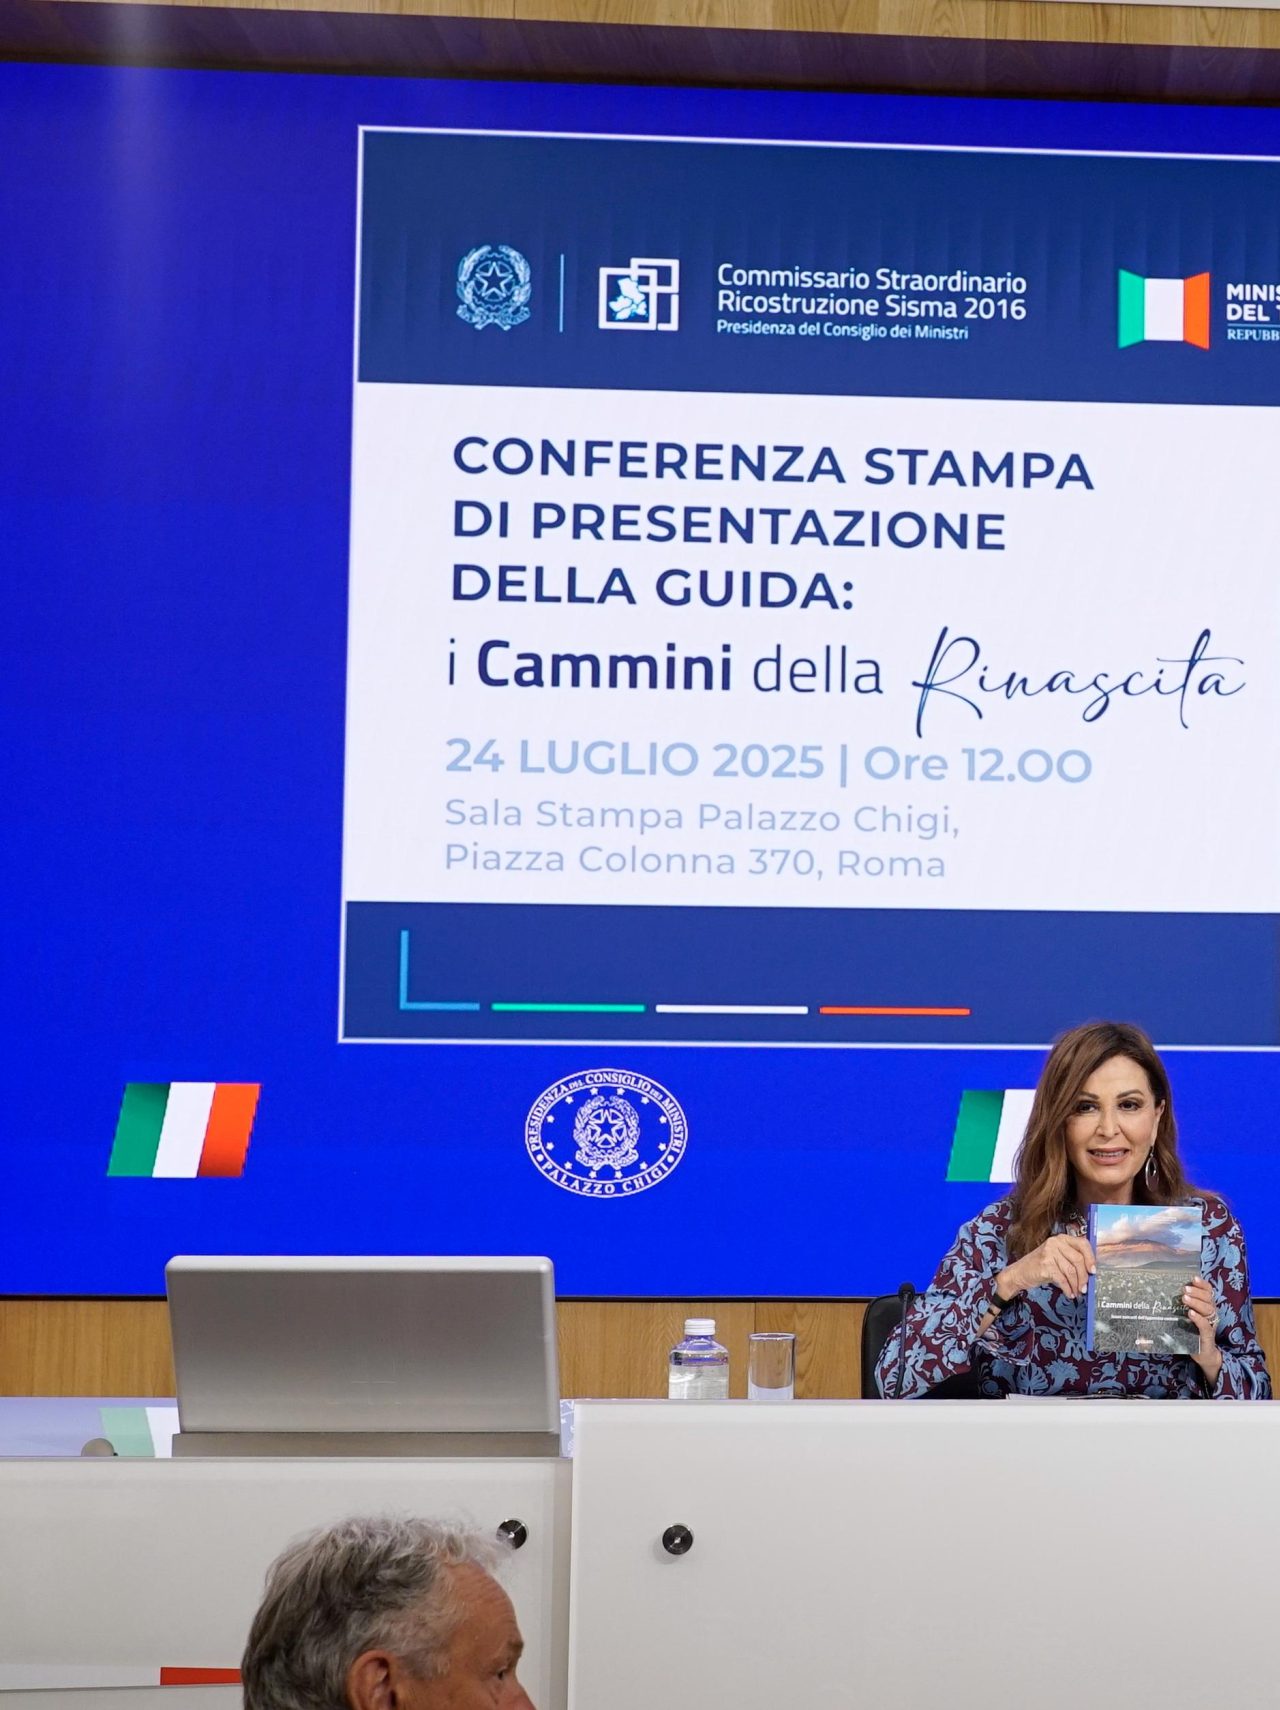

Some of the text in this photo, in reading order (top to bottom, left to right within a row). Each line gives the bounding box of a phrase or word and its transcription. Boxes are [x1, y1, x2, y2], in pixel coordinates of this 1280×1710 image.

[717, 263, 1027, 294] Commissario Straordinario
[717, 289, 1027, 321] Ricostruzione Sisma 2016
[1226, 303, 1271, 322] DEL
[716, 319, 969, 342] Presidenza del Consiglio dei Ministri
[453, 436, 1095, 491] CONFERENZA STAMPA
[453, 499, 1006, 551] DI PRESENTAZIONE
[452, 563, 854, 611] DELLA GUIDA:
[448, 625, 1246, 739] i Cammini della Rinascita
[445, 737, 505, 773] 24
[519, 739, 699, 777] LUGLIO
[712, 742, 825, 780] 2025
[863, 745, 949, 781] Ore
[445, 798, 959, 841] Sala Stampa Palazzo Chigi,
[445, 841, 945, 881] Piazza Colonna 370, Roma
[528, 1085, 570, 1151] PRESIDENZA
[585, 1072, 651, 1092] CONSIGLIO
[661, 1098, 684, 1153] MINISTRI
[541, 1162, 668, 1194] PALAZZO CHIGI
